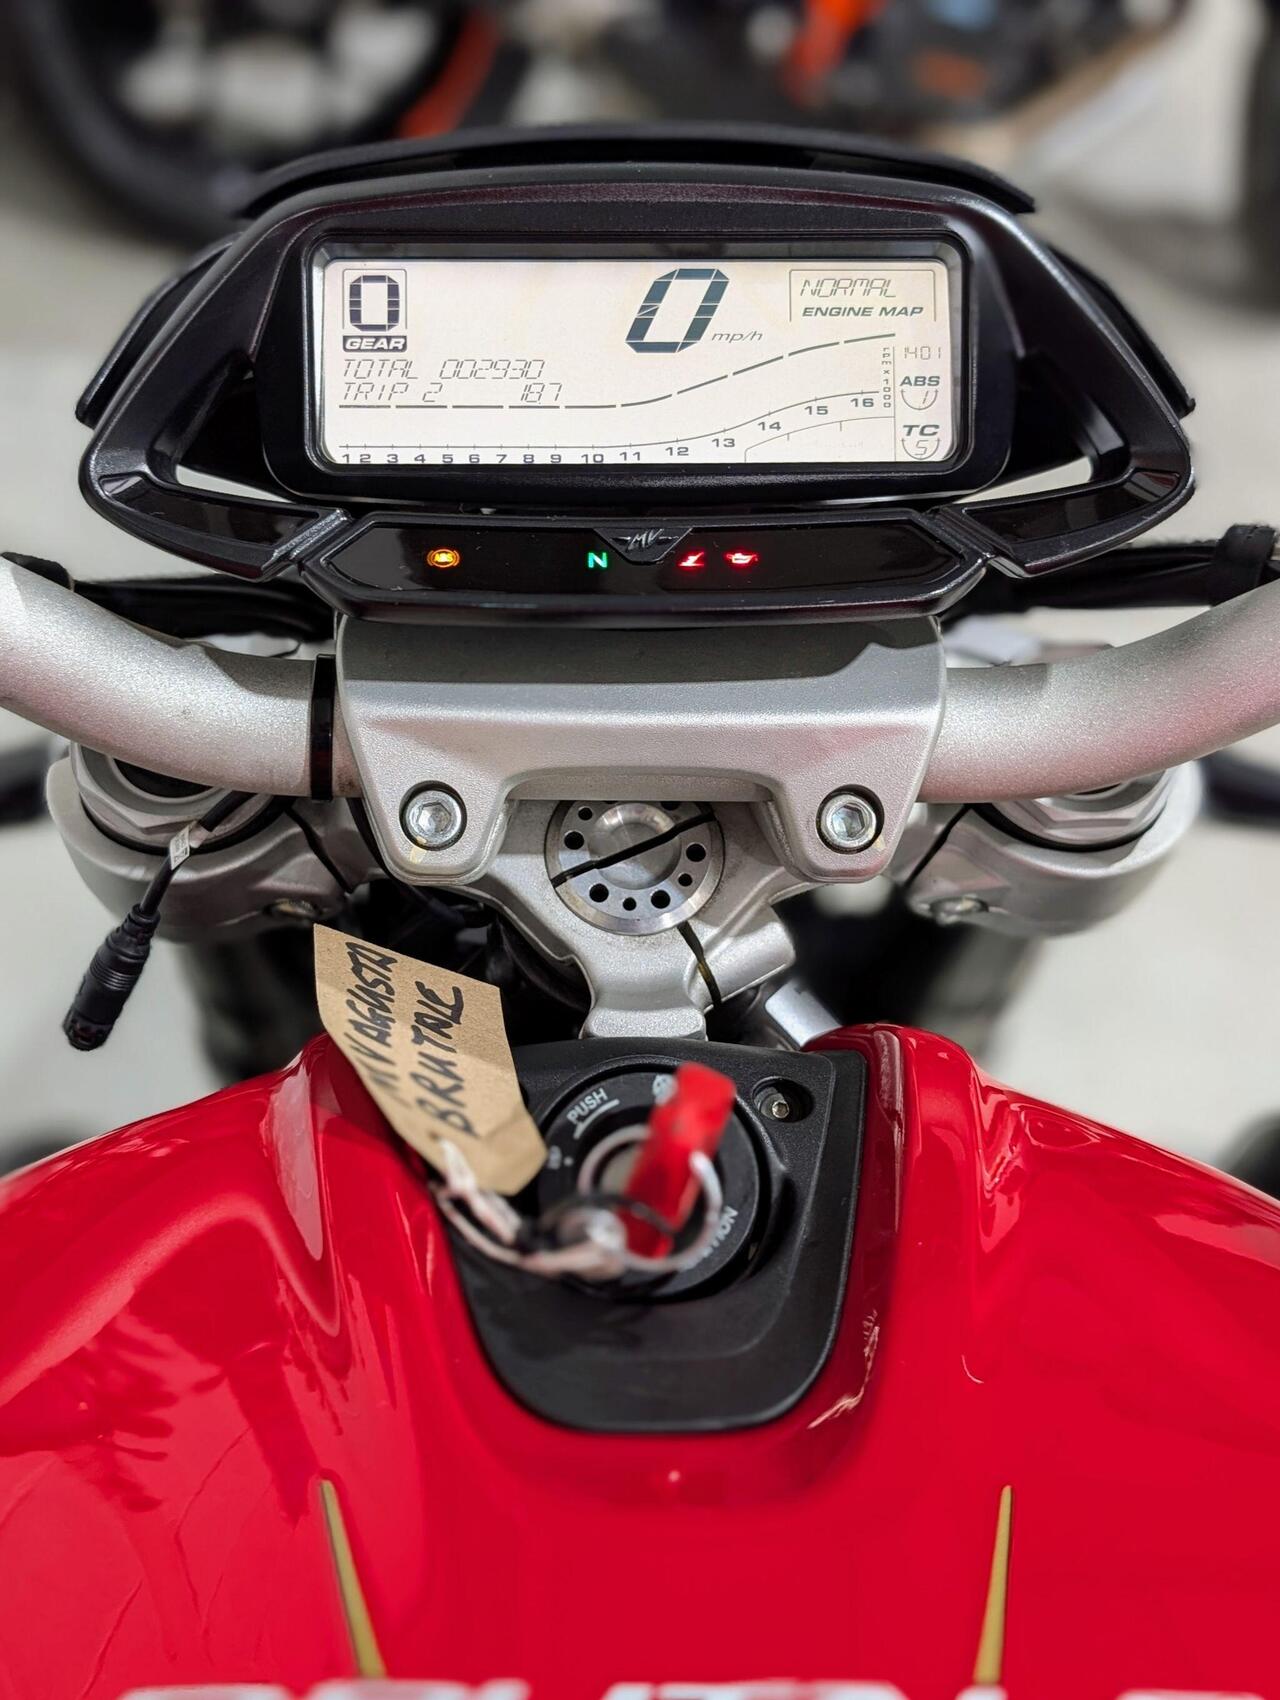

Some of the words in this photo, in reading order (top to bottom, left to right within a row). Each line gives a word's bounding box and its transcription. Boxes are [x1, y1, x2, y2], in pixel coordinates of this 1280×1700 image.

[800, 278, 897, 298] NORMAL
[349, 275, 400, 332] 0
[625, 268, 730, 353] 0
[802, 306, 874, 318] ENGINE
[879, 306, 924, 317] MAP
[344, 337, 406, 351] GEAR
[711, 331, 763, 343] mp/h
[344, 359, 418, 379] TOTAL
[439, 359, 545, 379] 002930
[900, 375, 941, 387] ABS
[344, 382, 409, 401] TRIP
[422, 382, 443, 402] 2
[342, 454, 350, 463] 1
[359, 454, 371, 463] 2
[387, 454, 399, 464] 3
[414, 454, 426, 463] 4
[442, 454, 454, 464] 5
[469, 454, 480, 464] 6
[496, 454, 507, 464] 7
[523, 454, 535, 464] 8
[550, 454, 562, 464] 9
[581, 454, 604, 464] 10
[619, 452, 641, 461] 11
[665, 447, 689, 456] 12
[712, 438, 736, 448] 13
[758, 421, 782, 431] 14
[804, 405, 828, 415] 15
[850, 398, 874, 408] 16
[903, 424, 940, 437] TC
[588, 552, 608, 568] N
[410, 980, 482, 1139] BRUTALE
[566, 1087, 608, 1125] PUSH
